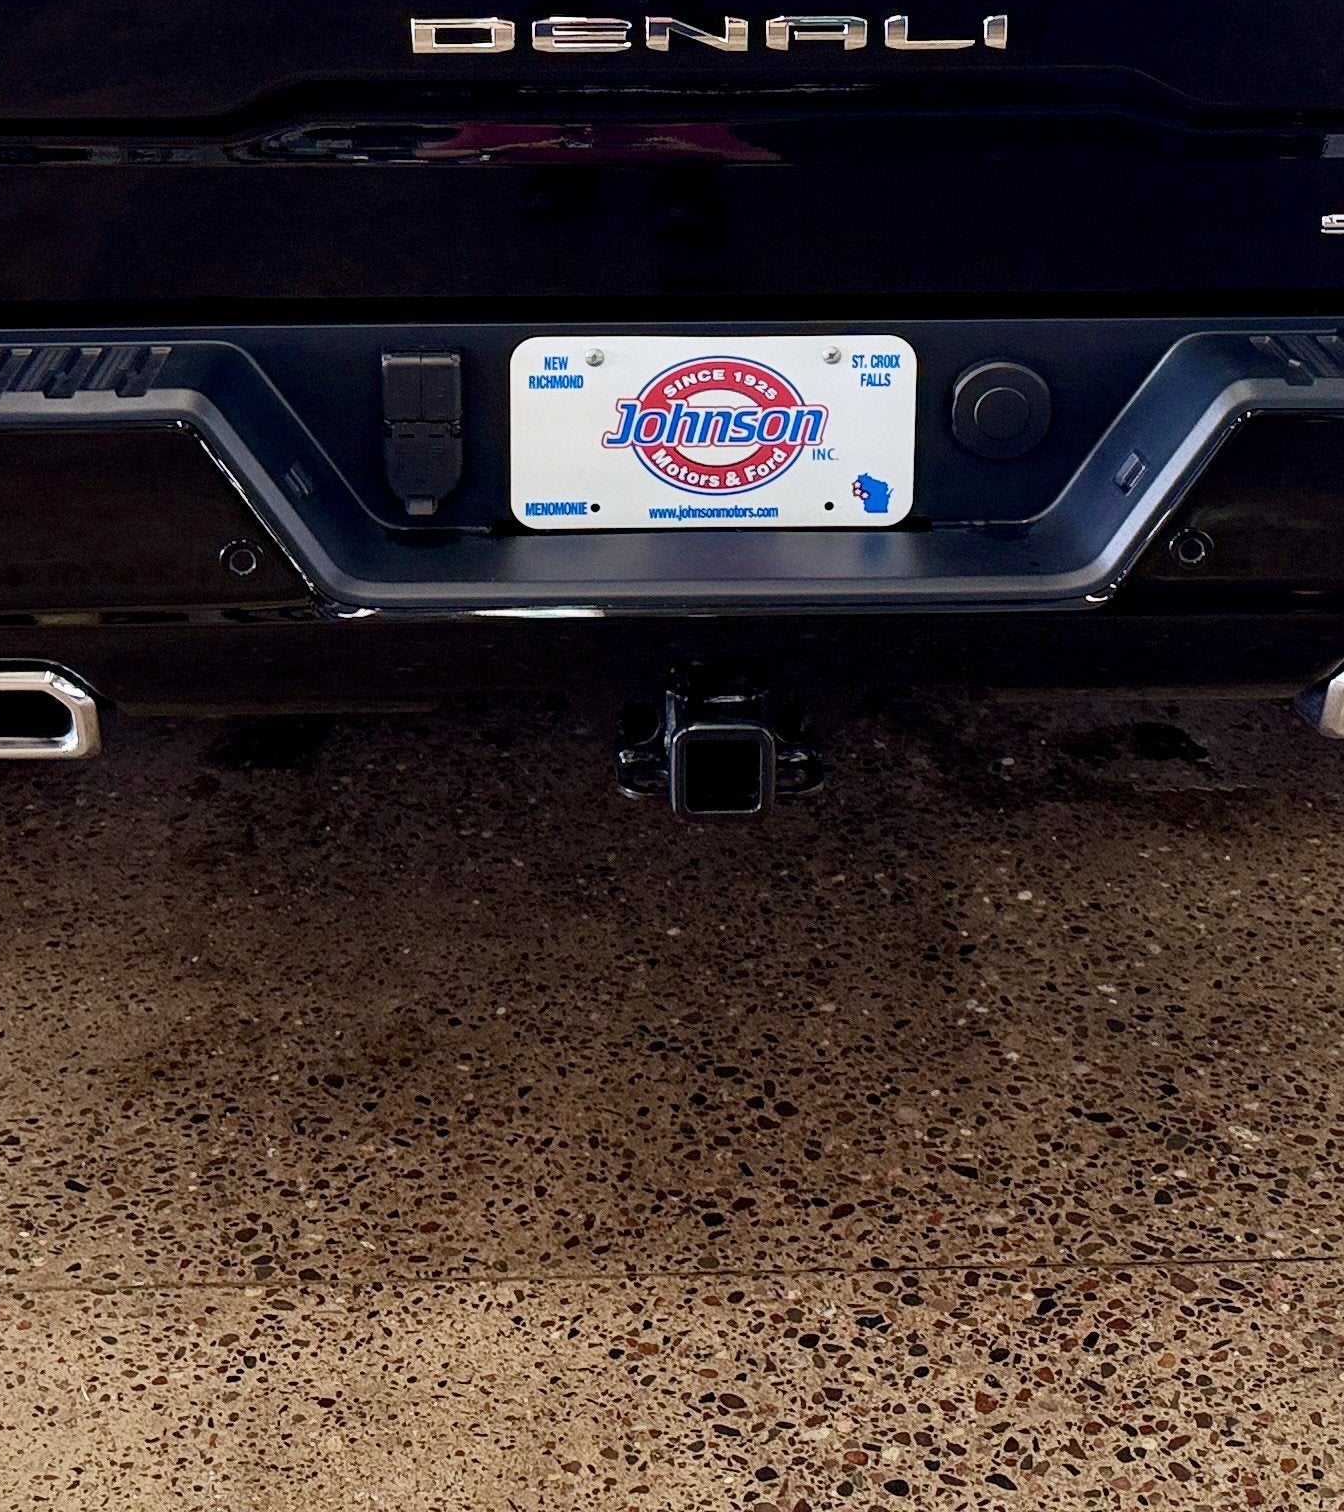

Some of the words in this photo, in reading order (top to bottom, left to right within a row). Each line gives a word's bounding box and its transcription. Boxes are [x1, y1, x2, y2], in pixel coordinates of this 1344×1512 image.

[410, 15, 1009, 54] DENALI
[544, 356, 569, 371] NEW
[851, 354, 868, 369] ST.
[870, 354, 901, 369] CROIX
[528, 374, 584, 390] RICHMOND
[662, 368, 726, 398] SINCE
[733, 371, 779, 400] 1925
[860, 373, 892, 388] FALLS
[604, 401, 825, 446] Johnson
[812, 448, 840, 461] INC.
[650, 448, 721, 488] Motors
[725, 471, 742, 487] &
[743, 447, 788, 482] Ford
[525, 501, 588, 517] MENOMONIE
[649, 504, 779, 522] www.johnsonmotors.com
